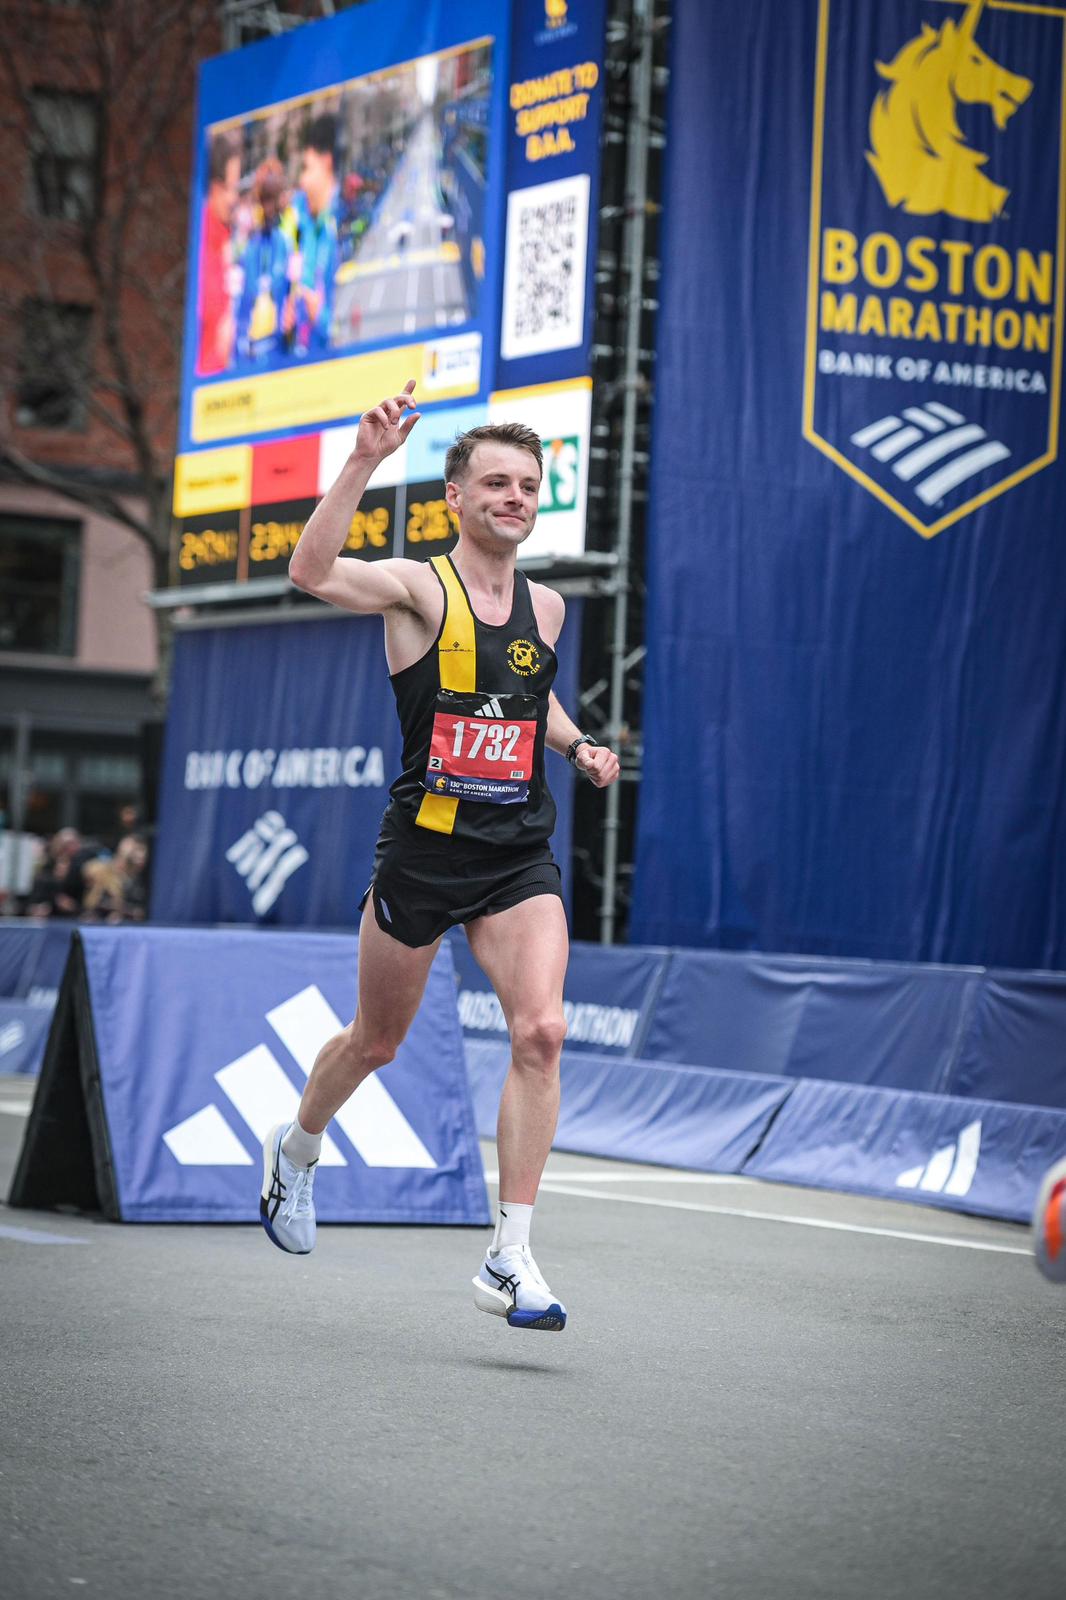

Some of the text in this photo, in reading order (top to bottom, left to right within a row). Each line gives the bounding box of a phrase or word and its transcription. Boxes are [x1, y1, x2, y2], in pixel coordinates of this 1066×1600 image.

[822, 227, 1053, 304] BOSTON
[820, 291, 1051, 352] MARATHON
[818, 350, 1047, 394] BANK OF AMERICA
[431, 758, 440, 768] 2
[452, 720, 521, 762] 1732
[271, 745, 385, 789] AMERICA
[463, 783, 488, 791] BOSTON
[488, 785, 520, 793] MARATHON
